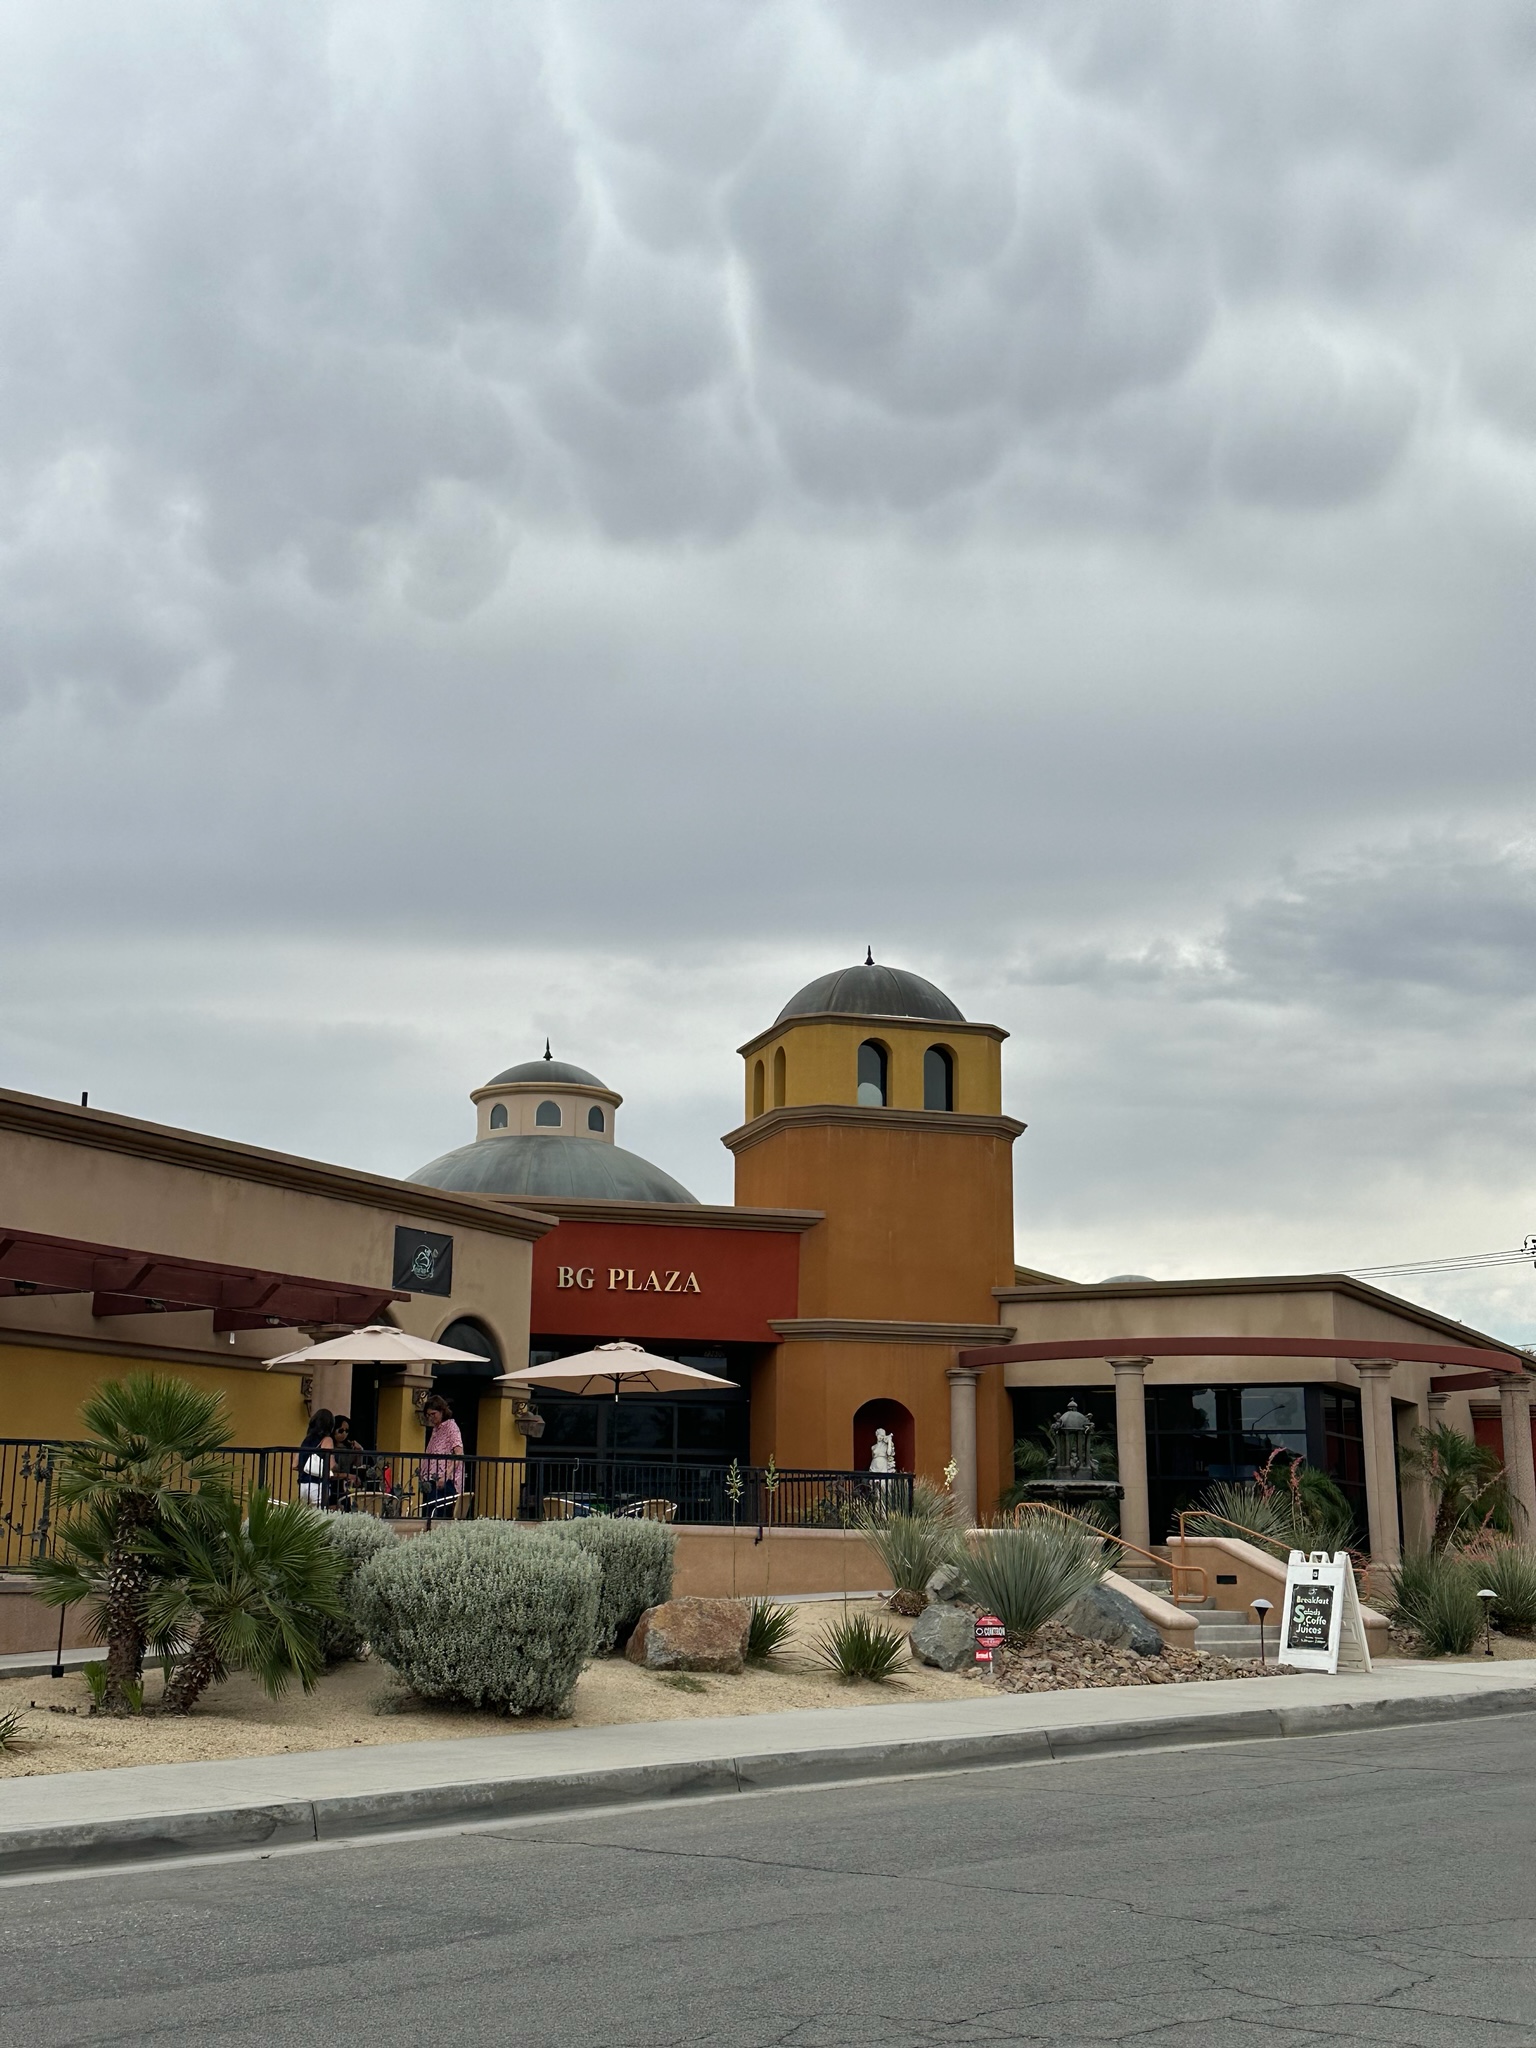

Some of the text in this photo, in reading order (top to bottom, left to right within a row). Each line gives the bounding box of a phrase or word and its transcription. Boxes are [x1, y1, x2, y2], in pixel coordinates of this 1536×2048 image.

[557, 1266, 701, 1293] BG PLAZA
[1296, 1596, 1329, 1604] Breakfast
[1296, 1624, 1322, 1634] Juices
